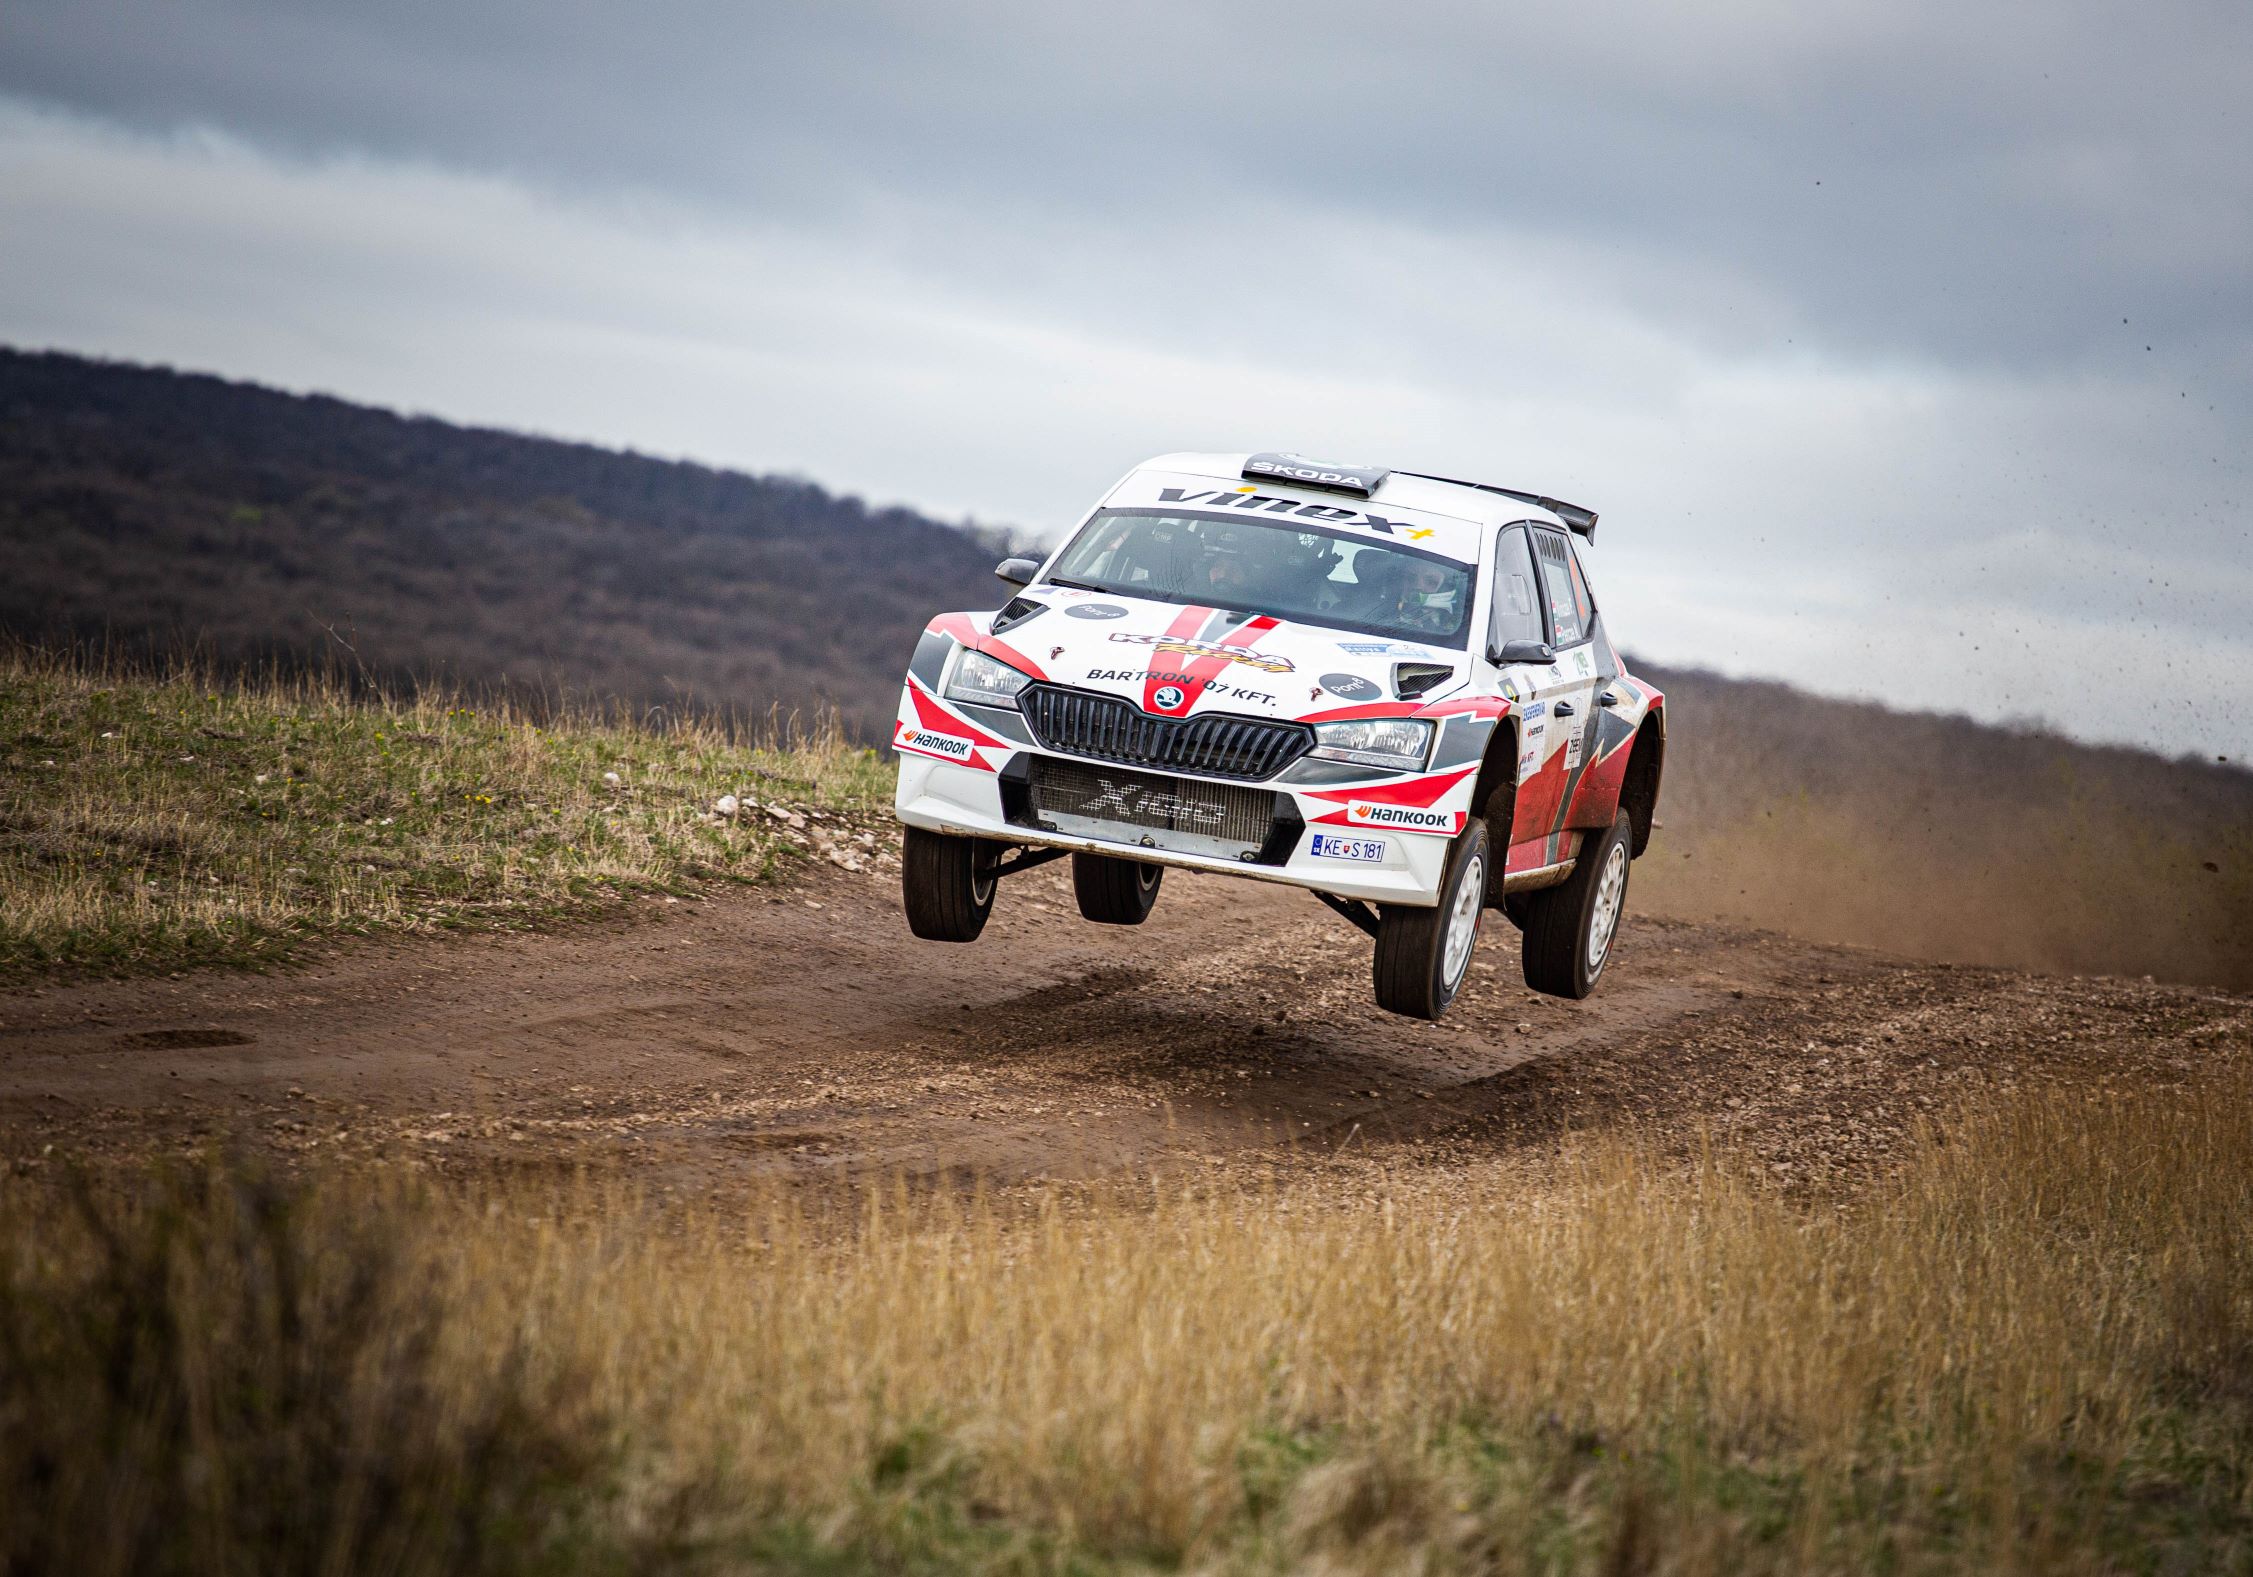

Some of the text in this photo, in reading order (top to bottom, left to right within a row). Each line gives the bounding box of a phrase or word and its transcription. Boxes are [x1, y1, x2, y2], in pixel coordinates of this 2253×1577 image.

[1251, 461, 1363, 487] ŠKODA
[1108, 632, 1296, 670] KORDA
[1086, 669, 1195, 685] BARTRON
[1231, 687, 1277, 707] KFT.
[1324, 838, 1382, 859] KE S 181
